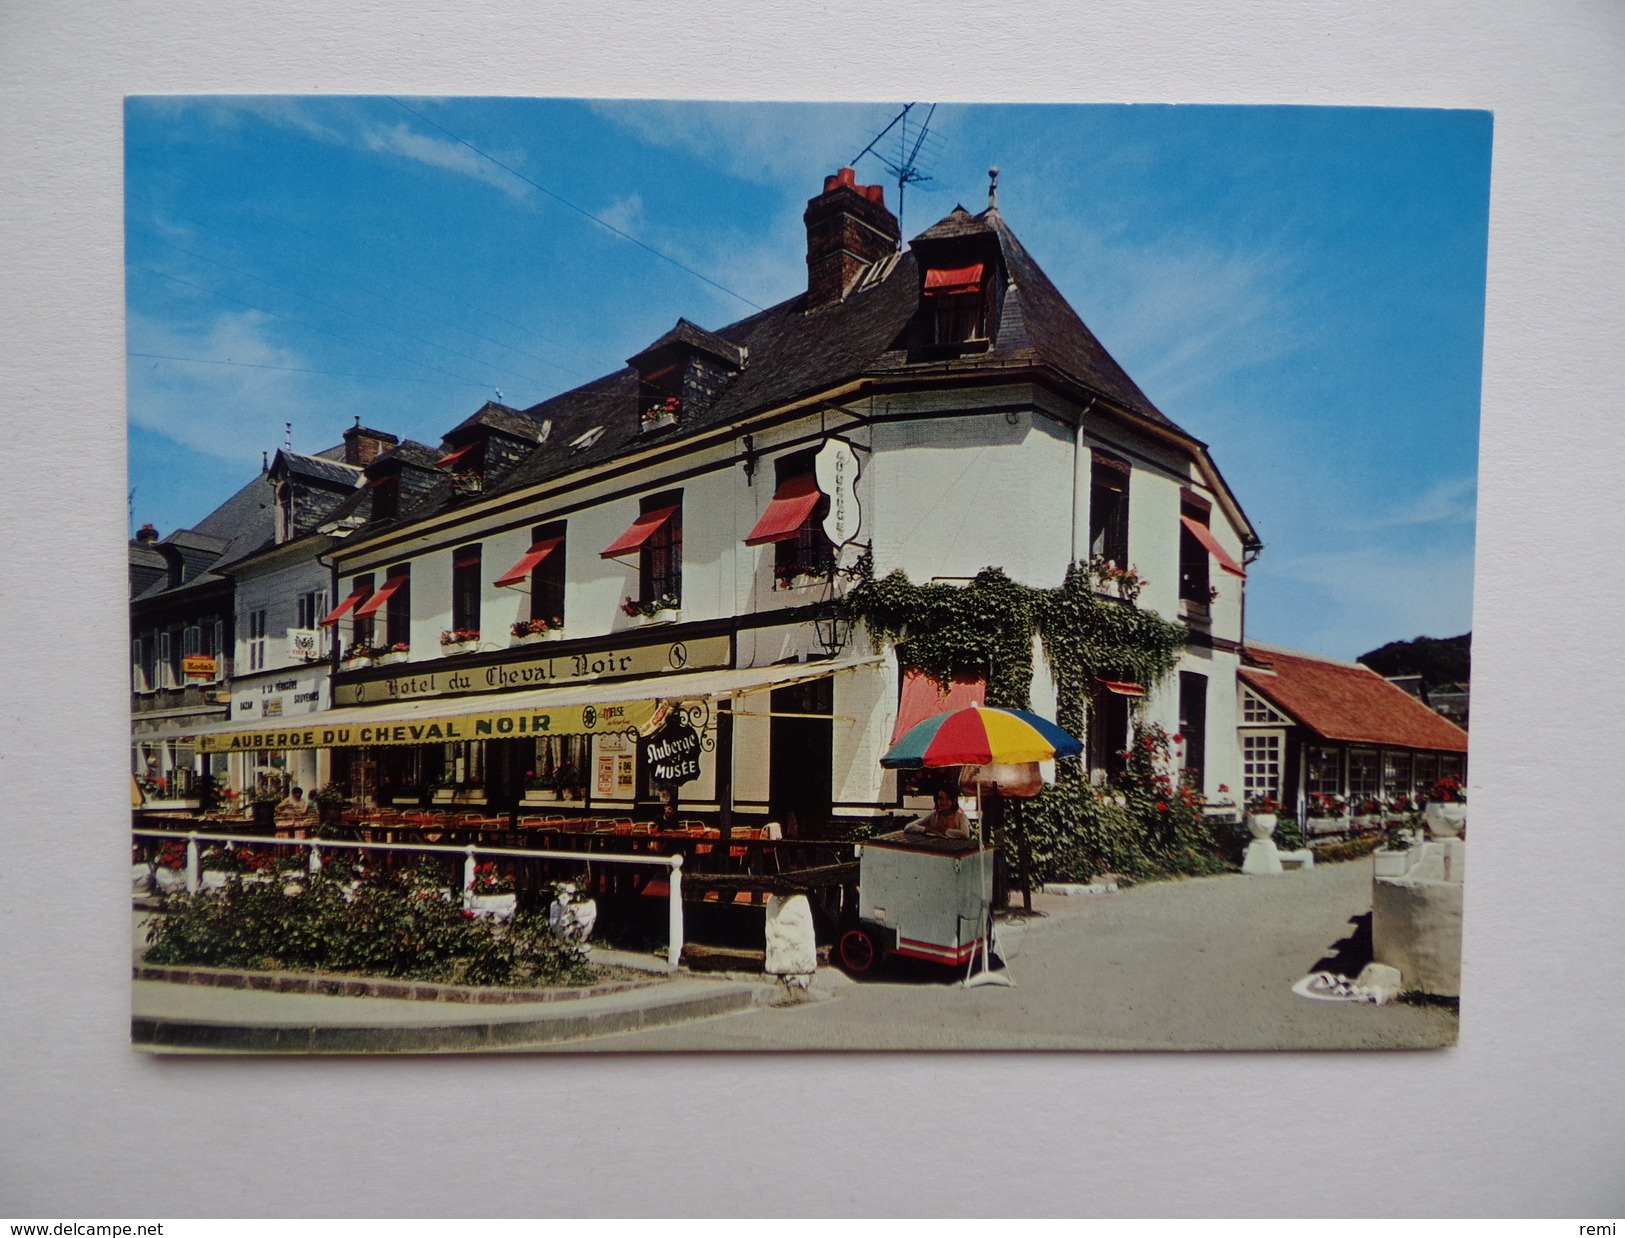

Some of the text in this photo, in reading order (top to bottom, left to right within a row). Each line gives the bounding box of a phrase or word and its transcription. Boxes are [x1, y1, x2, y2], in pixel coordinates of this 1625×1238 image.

[187, 662, 214, 671] Kodak
[386, 652, 632, 698] Hotel du Cheval Noir
[230, 731, 314, 749] AUBERGE
[322, 729, 350, 744] DU
[360, 722, 461, 741] CHEVAL
[475, 715, 550, 735] NOIR
[647, 735, 695, 764] Auberge
[655, 761, 696, 779] MUSÉE
